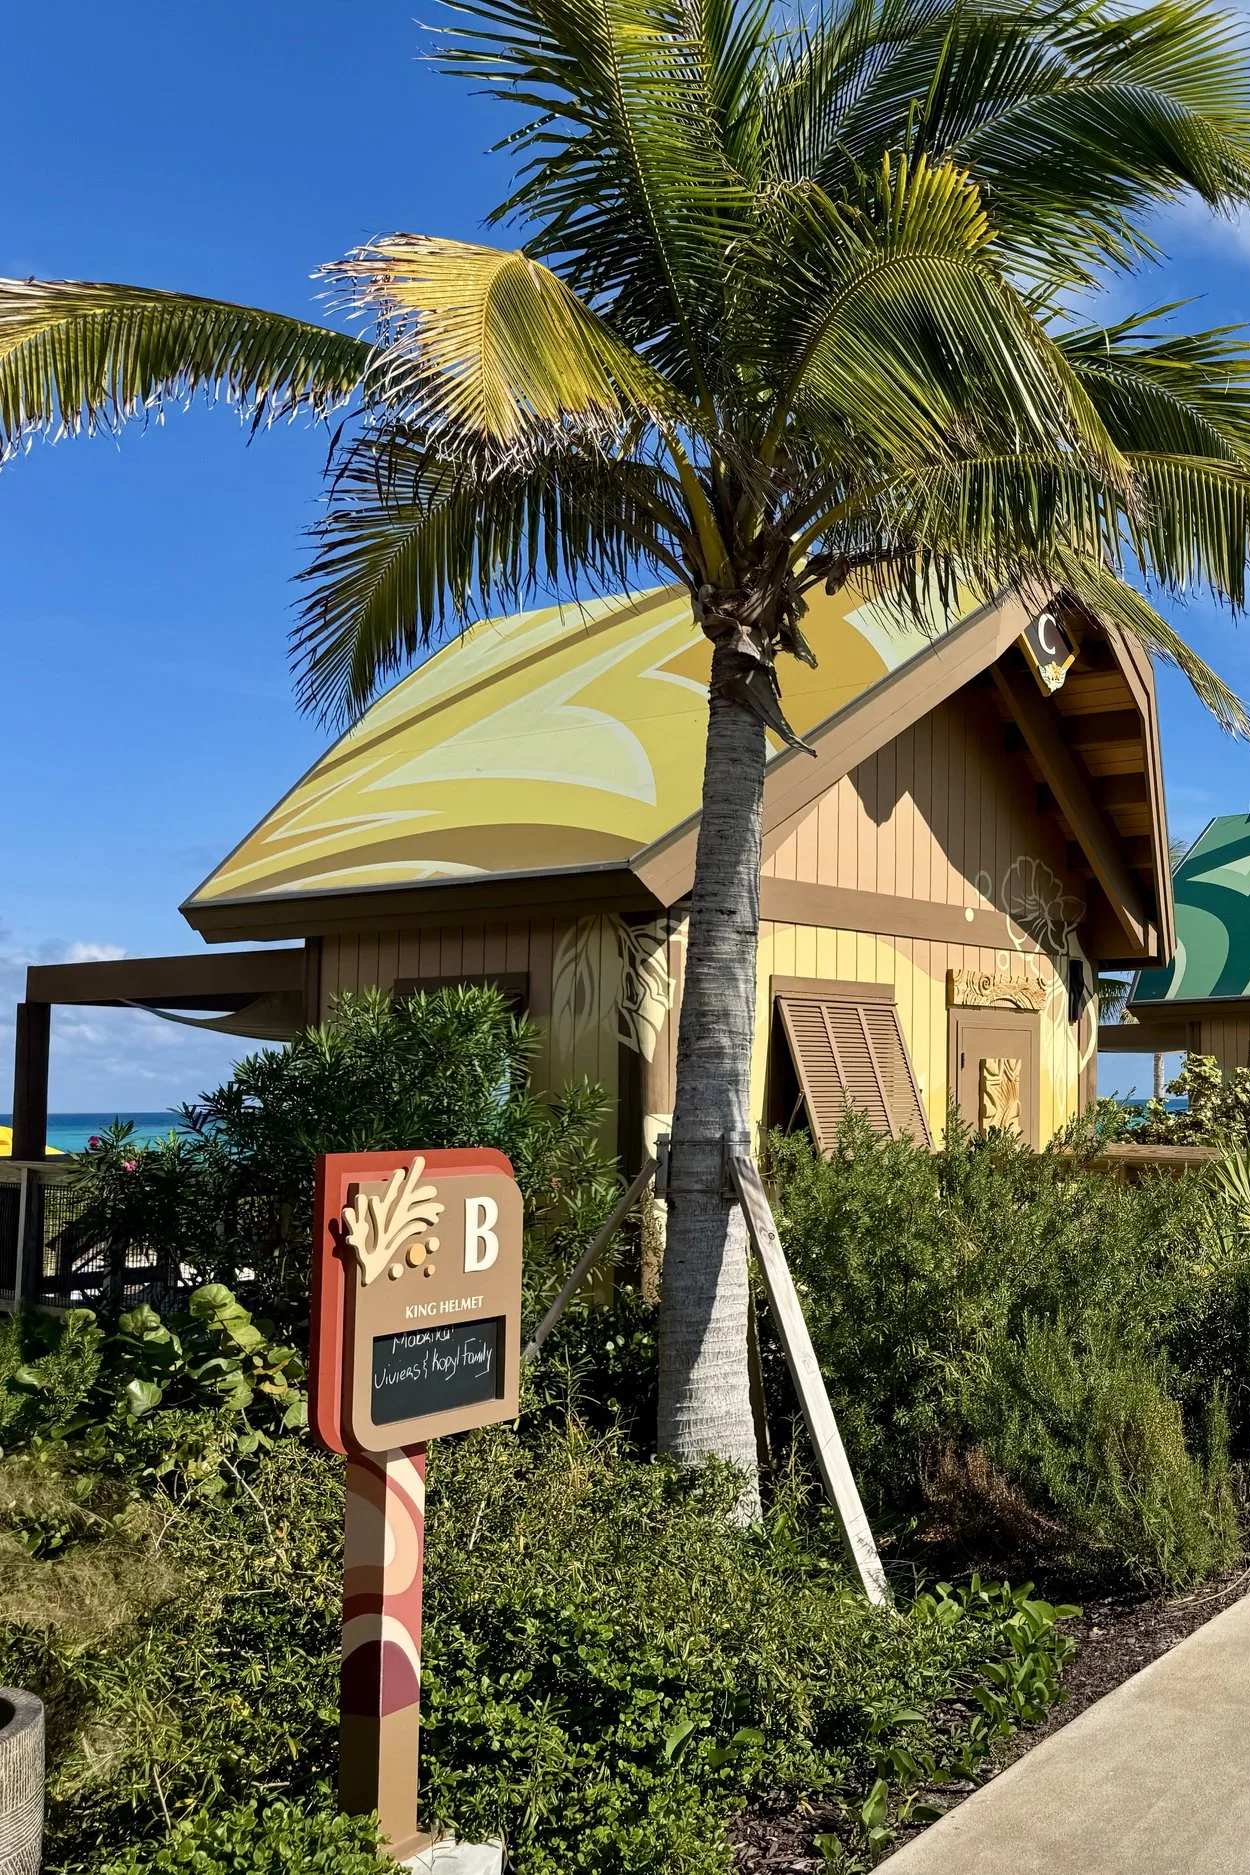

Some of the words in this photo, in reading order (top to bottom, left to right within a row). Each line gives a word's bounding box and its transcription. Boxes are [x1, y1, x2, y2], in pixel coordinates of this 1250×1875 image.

[1038, 613, 1057, 655] C
[463, 1196, 499, 1274] B
[405, 1302, 437, 1319] KING
[439, 1295, 484, 1314] HELMET
[462, 1337, 493, 1378] Family
